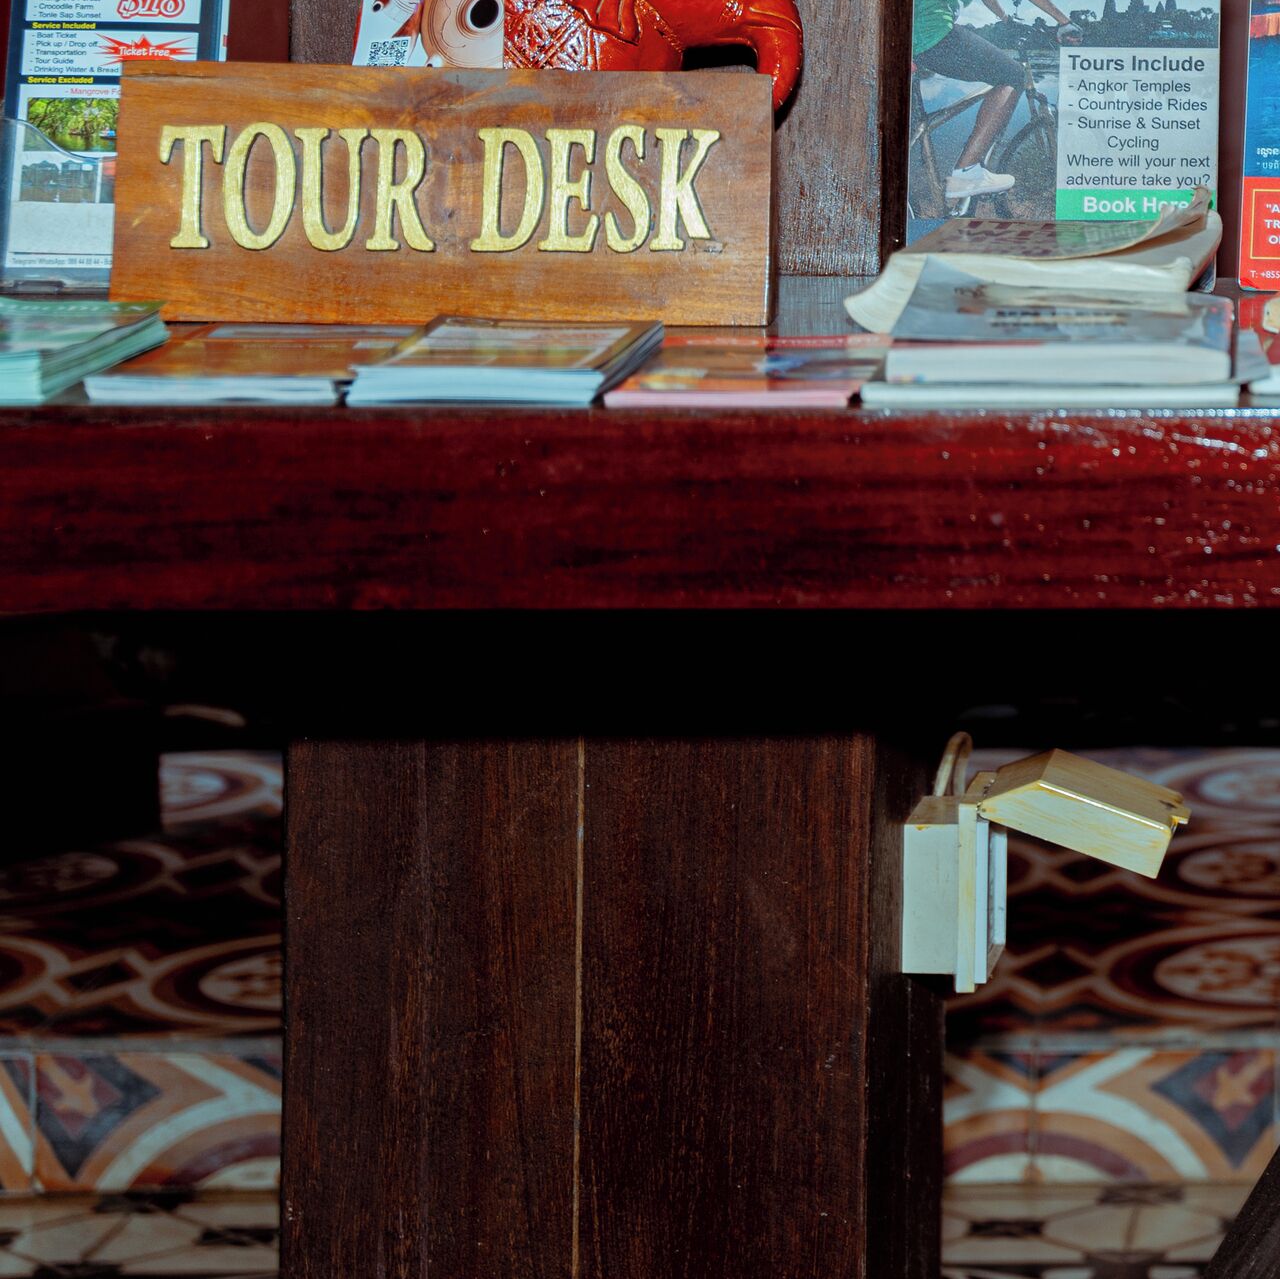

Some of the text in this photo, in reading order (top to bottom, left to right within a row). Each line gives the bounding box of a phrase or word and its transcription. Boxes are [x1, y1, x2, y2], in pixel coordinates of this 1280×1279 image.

[119, 47, 170, 56] Ticket Free
[1067, 54, 1205, 72] Tours Include
[1077, 79, 1191, 96] Angkor Temples
[1078, 98, 1208, 114] Countryside Rides
[1077, 116, 1201, 131] Sunrise & Sunset
[1107, 135, 1160, 152] Cycling
[1066, 154, 1211, 171] Where will your next
[157, 120, 725, 256] TOUR DESK
[1065, 173, 1211, 190] adventure take you?
[1082, 196, 1137, 214] Book
